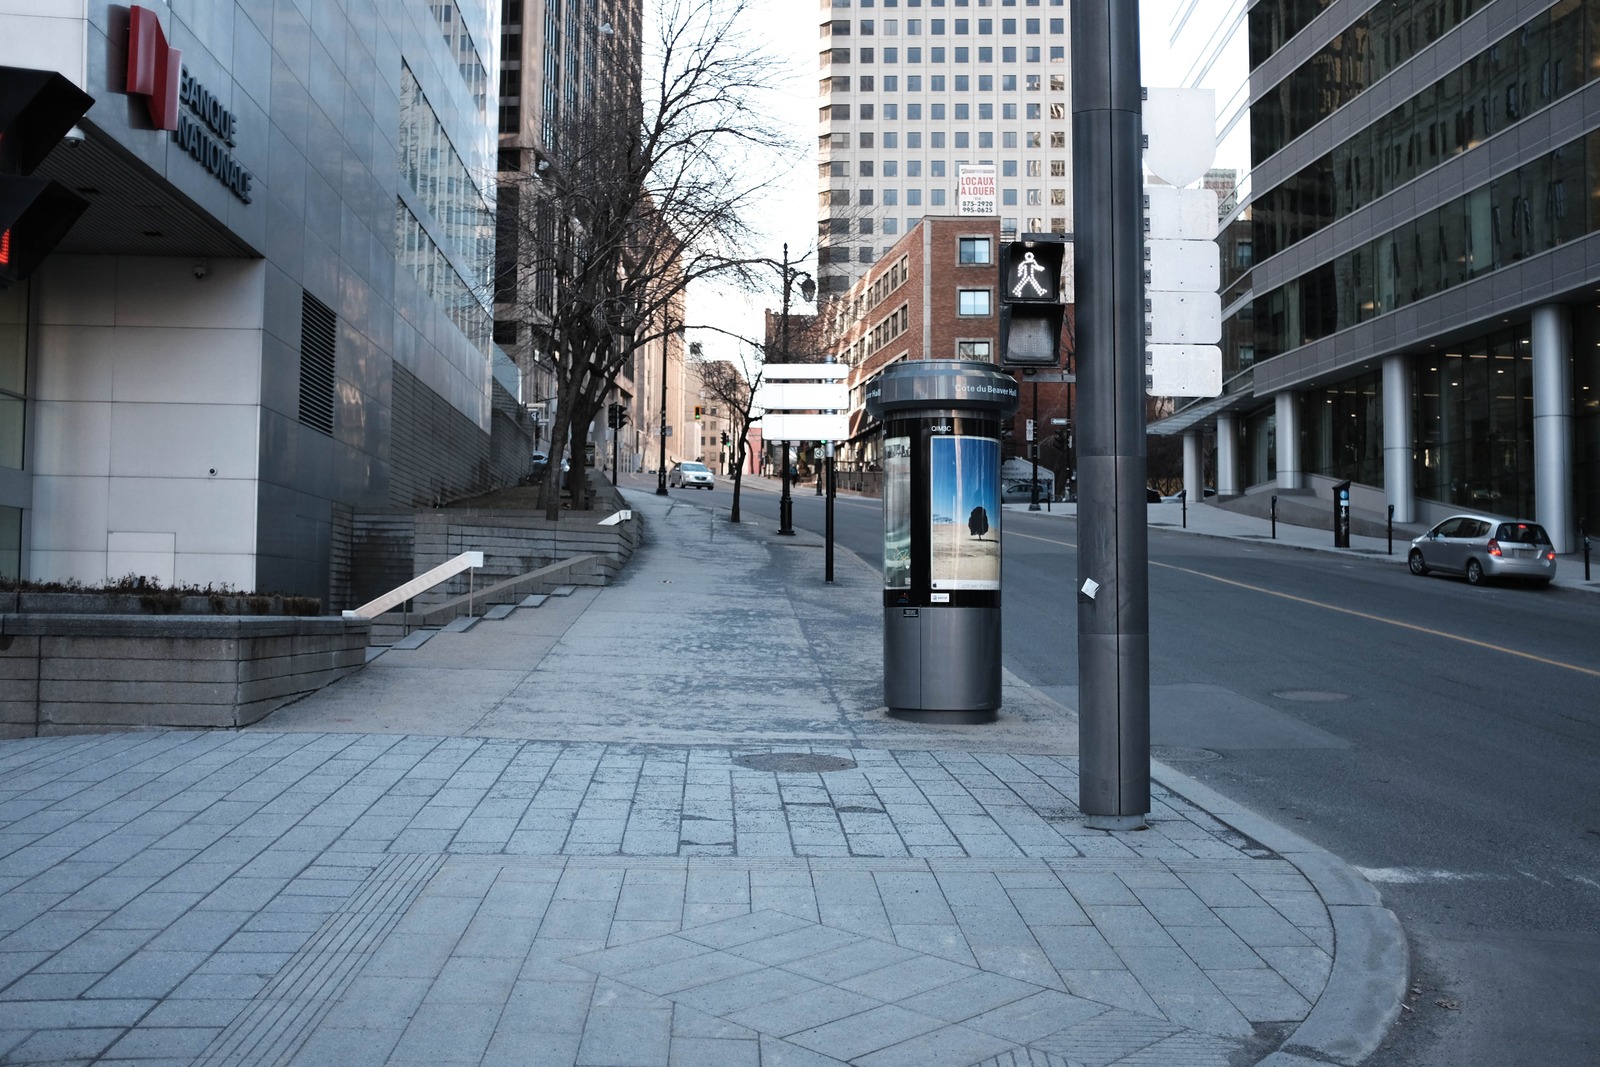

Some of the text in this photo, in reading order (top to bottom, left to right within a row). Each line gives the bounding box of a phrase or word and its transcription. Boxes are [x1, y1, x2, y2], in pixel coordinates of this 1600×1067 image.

[179, 62, 238, 147] BANQUE
[177, 113, 253, 205] NATIONALE
[961, 176, 994, 186] LOCAUX
[968, 187, 994, 196] LOUER
[976, 384, 987, 393] du
[988, 386, 1008, 394] Beaver
[1009, 388, 1017, 397] Hall
